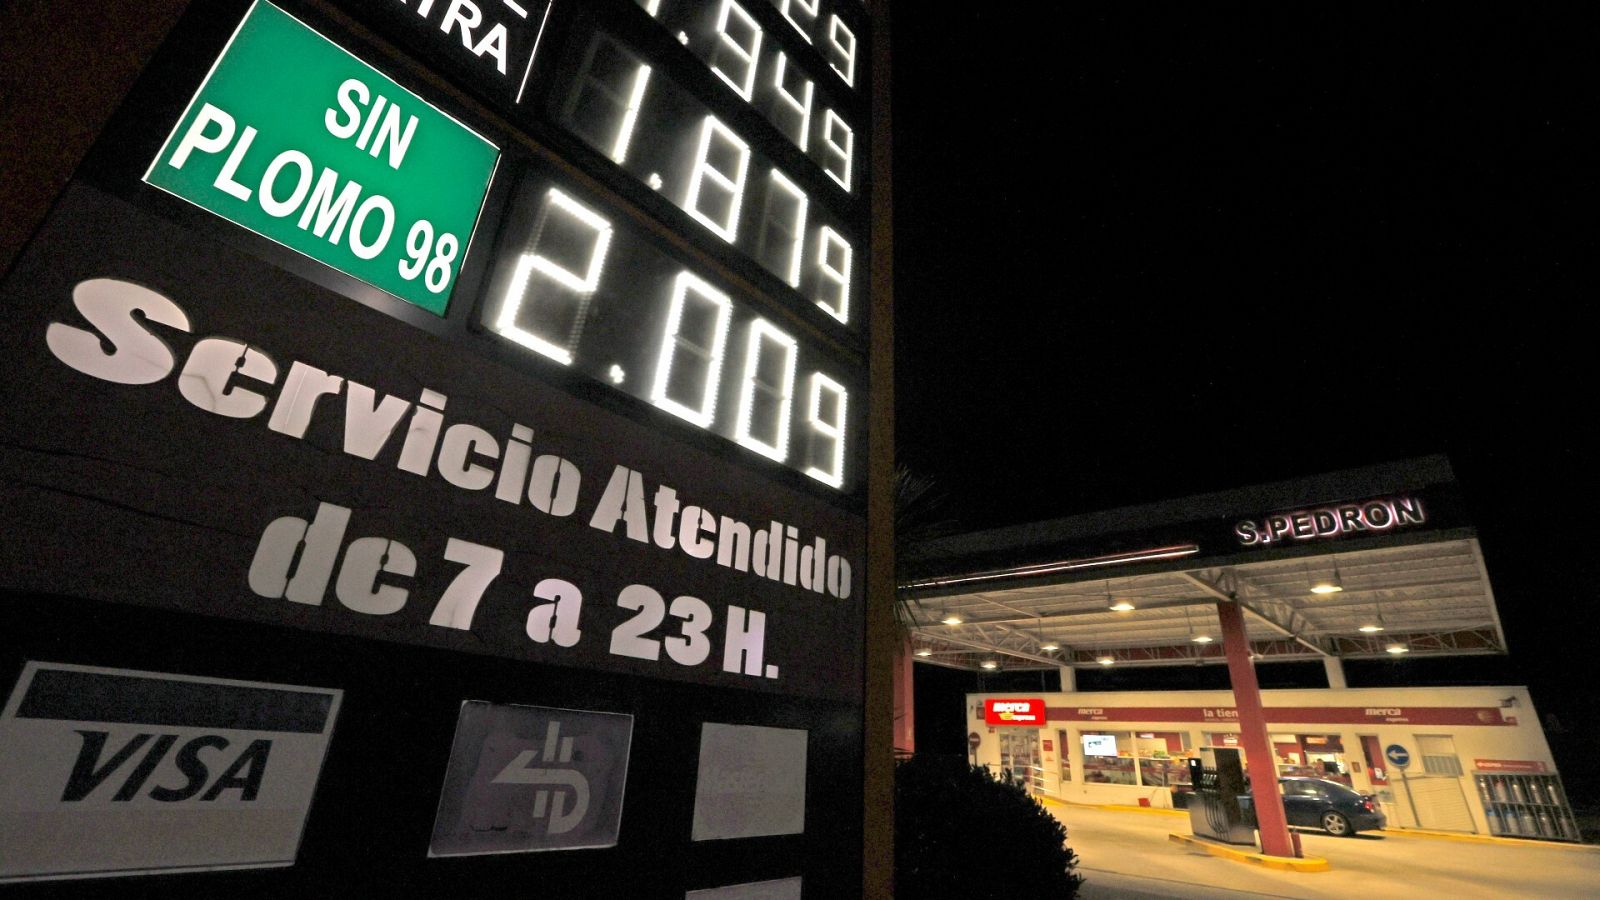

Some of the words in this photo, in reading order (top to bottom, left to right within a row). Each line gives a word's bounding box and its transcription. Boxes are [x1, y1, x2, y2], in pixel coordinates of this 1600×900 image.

[400, 0, 508, 76] RA
[324, 78, 419, 170] SIN
[646, 0, 854, 193] .949
[168, 102, 395, 260] PLOMO
[398, 220, 459, 294] 98
[611, 63, 853, 325] 1.879
[496, 187, 848, 489] 2.009
[46, 278, 581, 516] Servicio
[590, 464, 852, 600] Atendido
[1235, 497, 1426, 546] S.PEDRON
[248, 501, 418, 616] de
[428, 538, 504, 631] 7
[526, 577, 582, 648] a
[609, 584, 712, 667] 23
[724, 604, 779, 679] H.
[992, 701, 1031, 713] merca
[1077, 708, 1104, 716] merca
[1202, 708, 1214, 718] la
[1216, 708, 1239, 718] tien
[1364, 707, 1402, 716] merca
[60, 729, 273, 802] VISA
